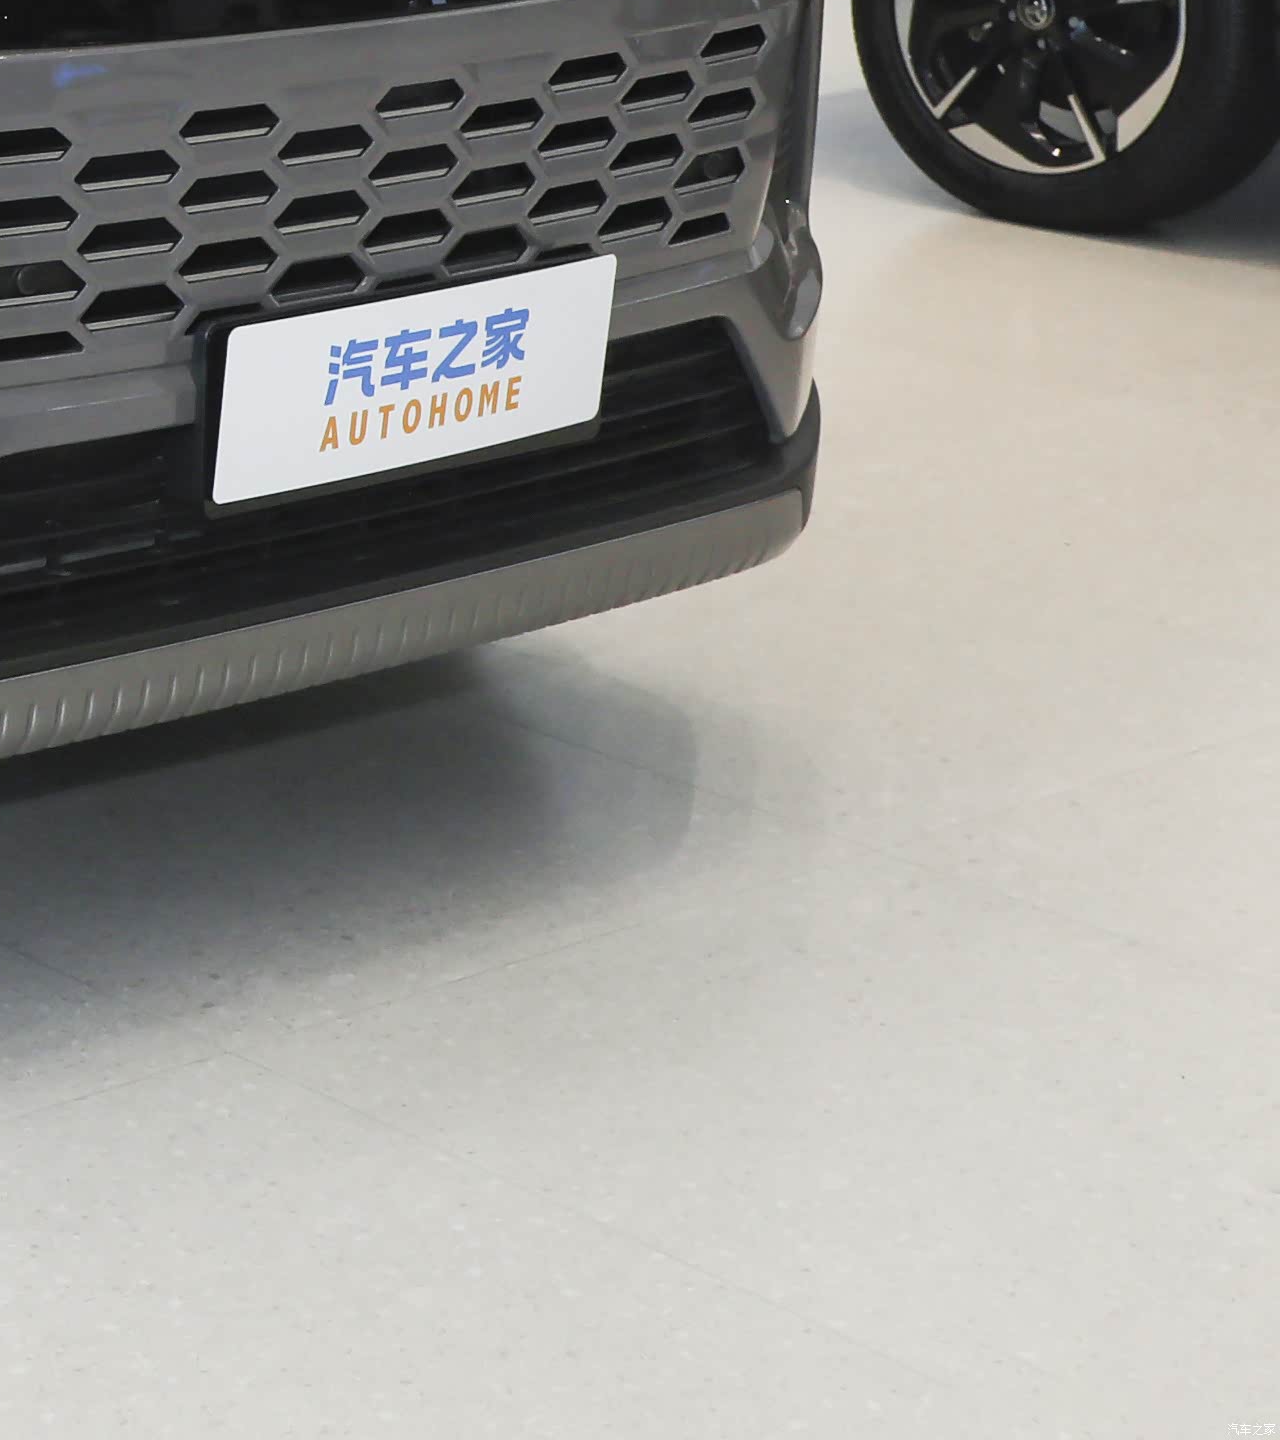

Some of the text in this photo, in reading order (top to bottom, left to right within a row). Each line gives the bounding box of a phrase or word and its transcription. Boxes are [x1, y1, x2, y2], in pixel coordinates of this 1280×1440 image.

[324, 307, 531, 407] 汽车之家
[320, 376, 523, 453] AUTOHOME
